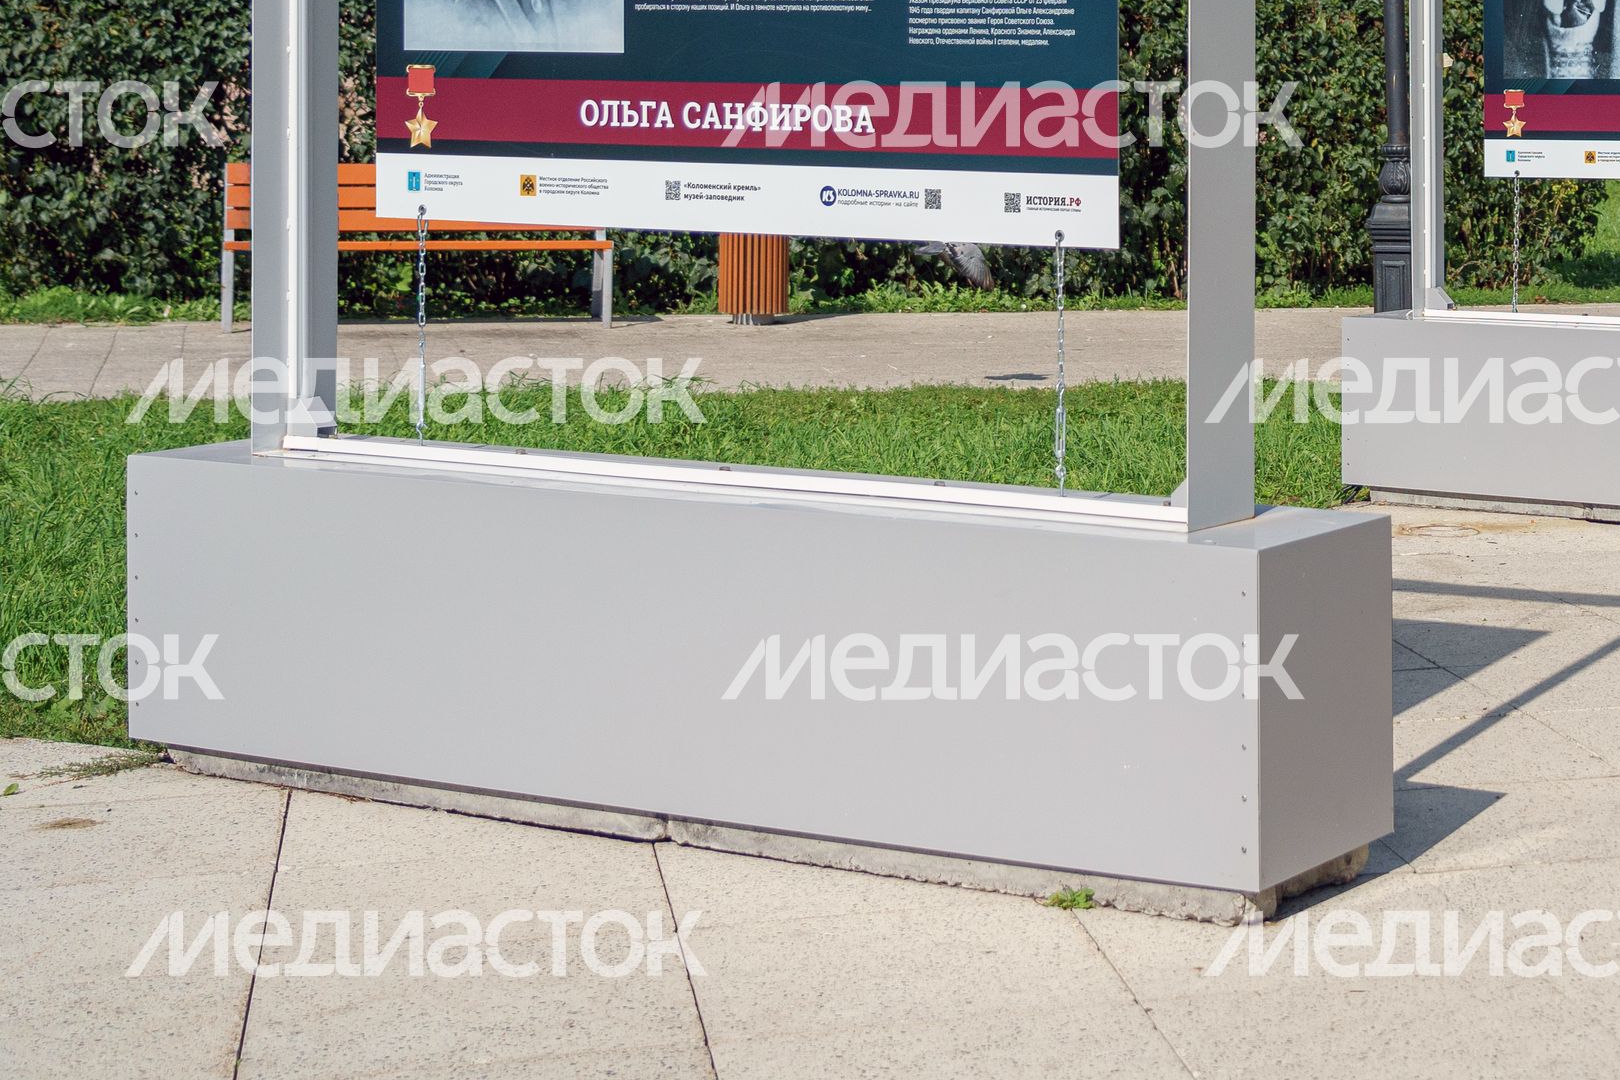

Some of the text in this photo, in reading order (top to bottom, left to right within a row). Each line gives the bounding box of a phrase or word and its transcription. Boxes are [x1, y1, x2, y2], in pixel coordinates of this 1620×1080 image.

[580, 99, 876, 133] ОЛЬГА САНФИРОВА
[684, 182, 732, 190] «Коломенский
[684, 194, 745, 202] музей-заповедник
[837, 188, 919, 200] KOLOMNA-SPRAVKA.RU
[837, 198, 868, 206] подробные
[1026, 196, 1082, 207] ИСТОРИЯ.РФ
